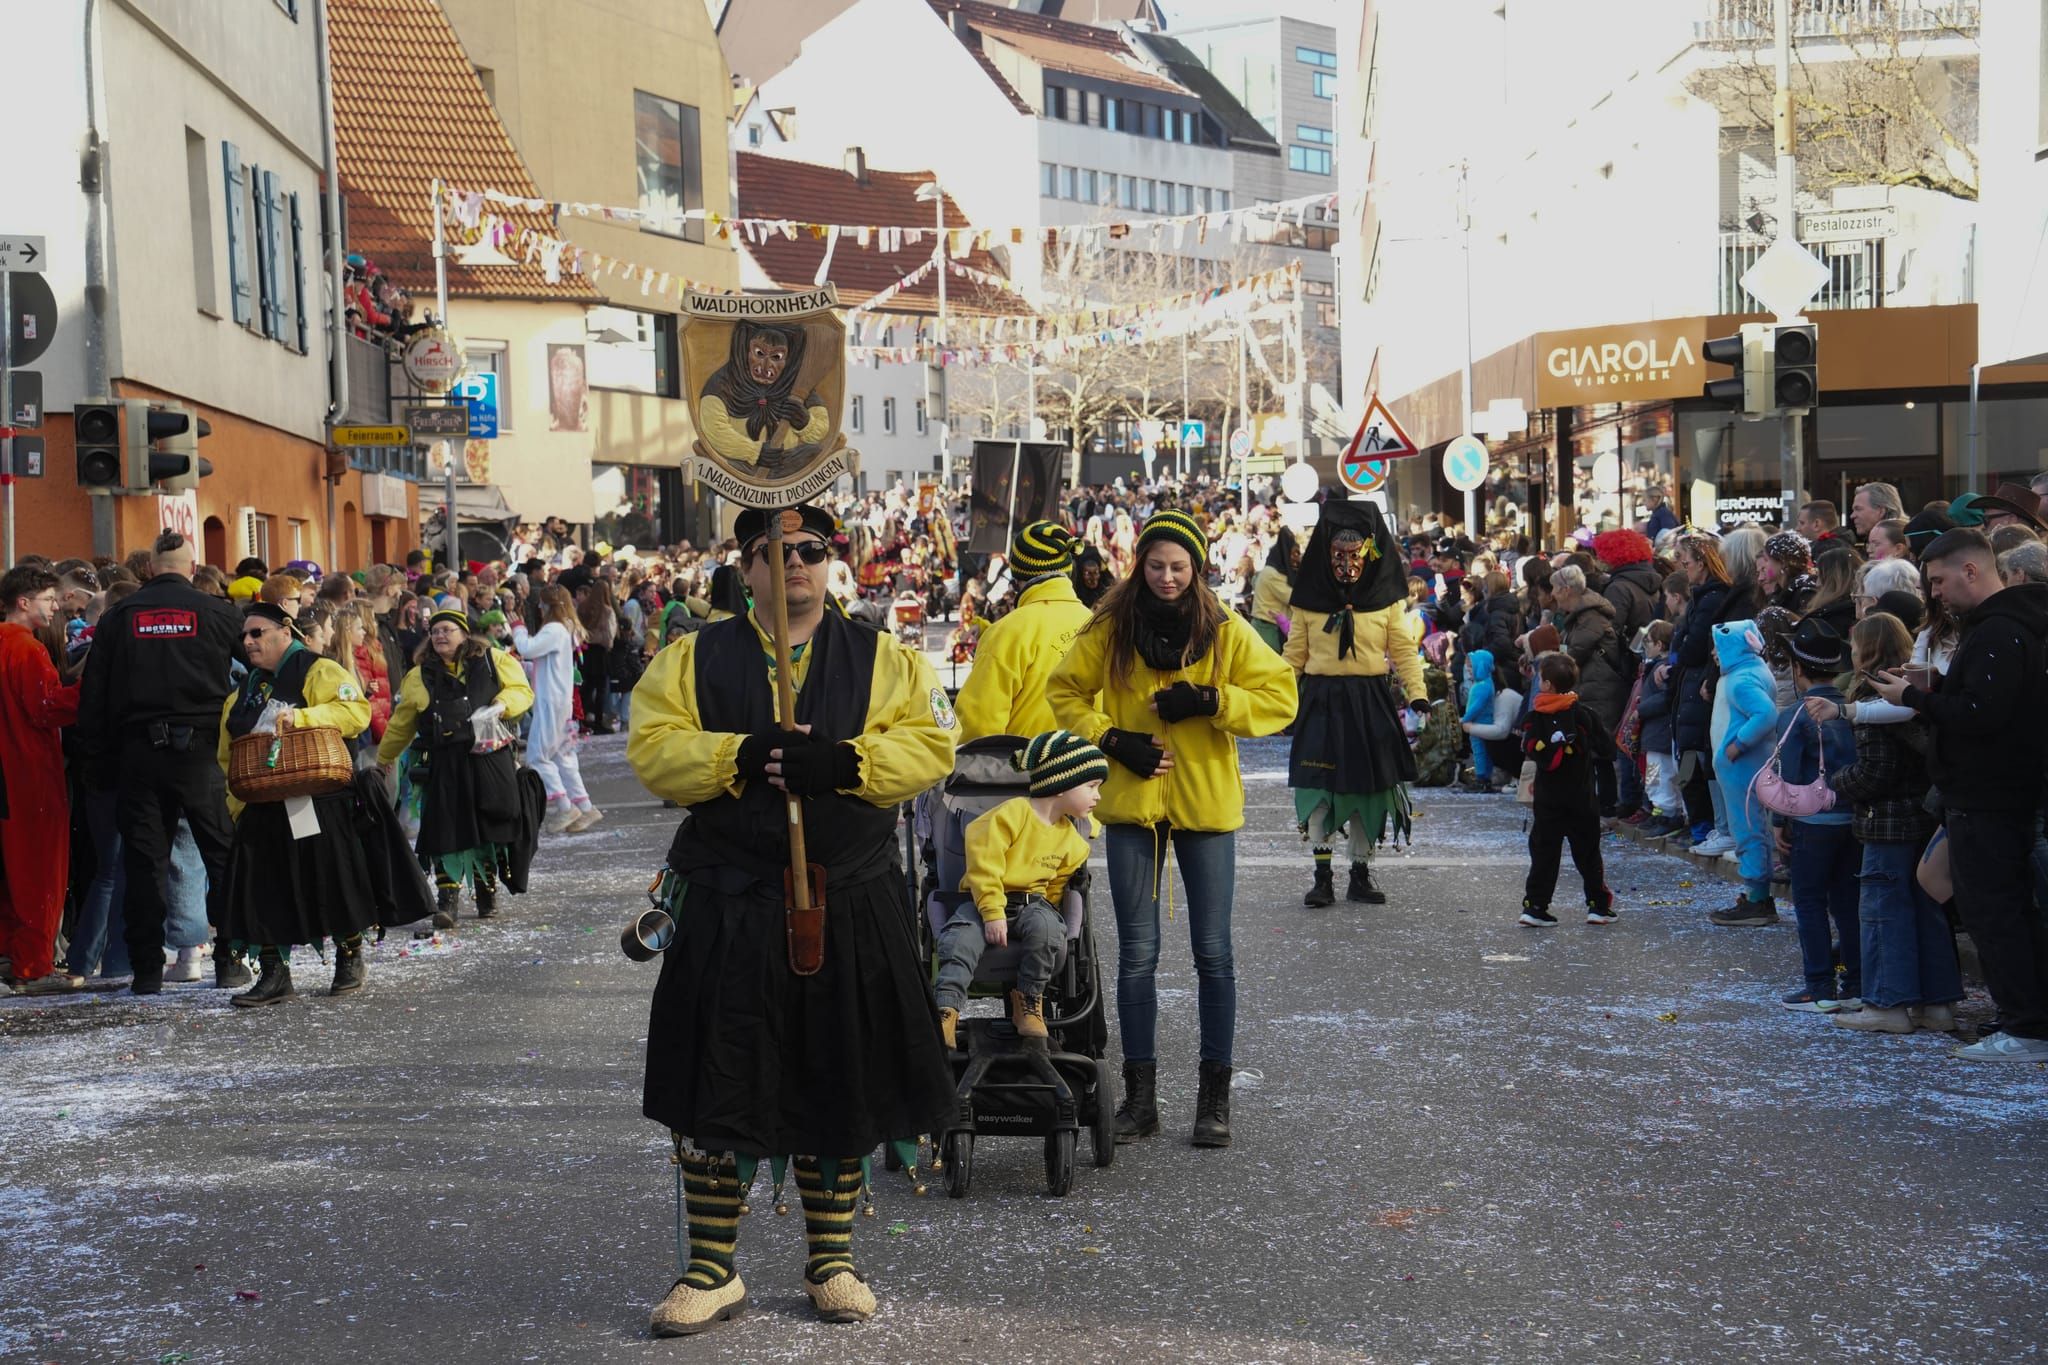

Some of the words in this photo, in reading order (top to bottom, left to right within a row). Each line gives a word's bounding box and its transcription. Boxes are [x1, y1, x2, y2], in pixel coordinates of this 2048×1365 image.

[691, 292, 832, 314] WALDHORNHEXA
[1548, 336, 1695, 377] GIAROLA
[1575, 370, 1670, 387] VINOTHEK
[348, 430, 394, 441] Feierraum
[787, 456, 844, 503] PLOCHINGEN
[1721, 511, 1774, 523] GIAROLA
[139, 624, 192, 633] SECURITY
[977, 1114, 1033, 1124] easywalker
